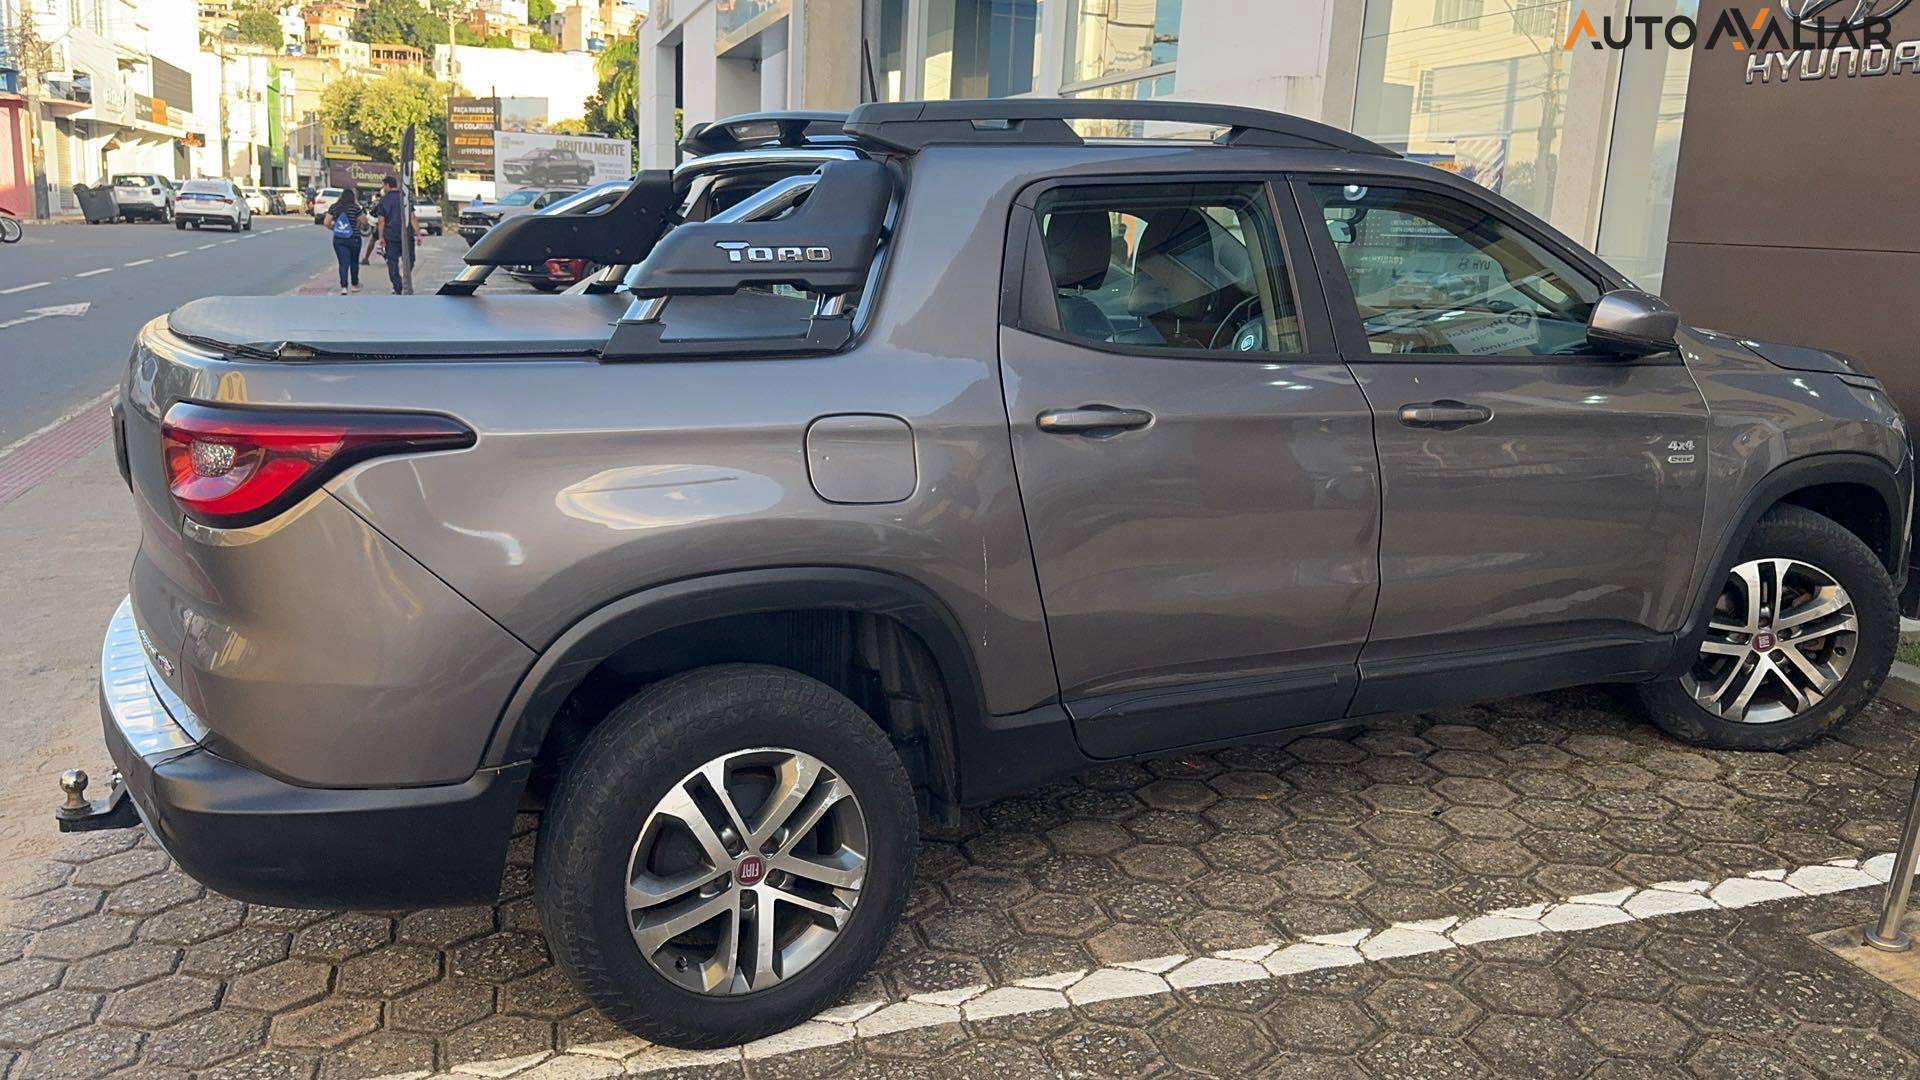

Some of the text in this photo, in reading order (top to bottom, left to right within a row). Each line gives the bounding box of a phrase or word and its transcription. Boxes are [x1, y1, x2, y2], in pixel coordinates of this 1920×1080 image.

[556, 140, 625, 157] BRUTALMENTE
[715, 241, 832, 262] TORO
[1668, 440, 1695, 451] 4x4
[740, 862, 760, 879] FIAT
